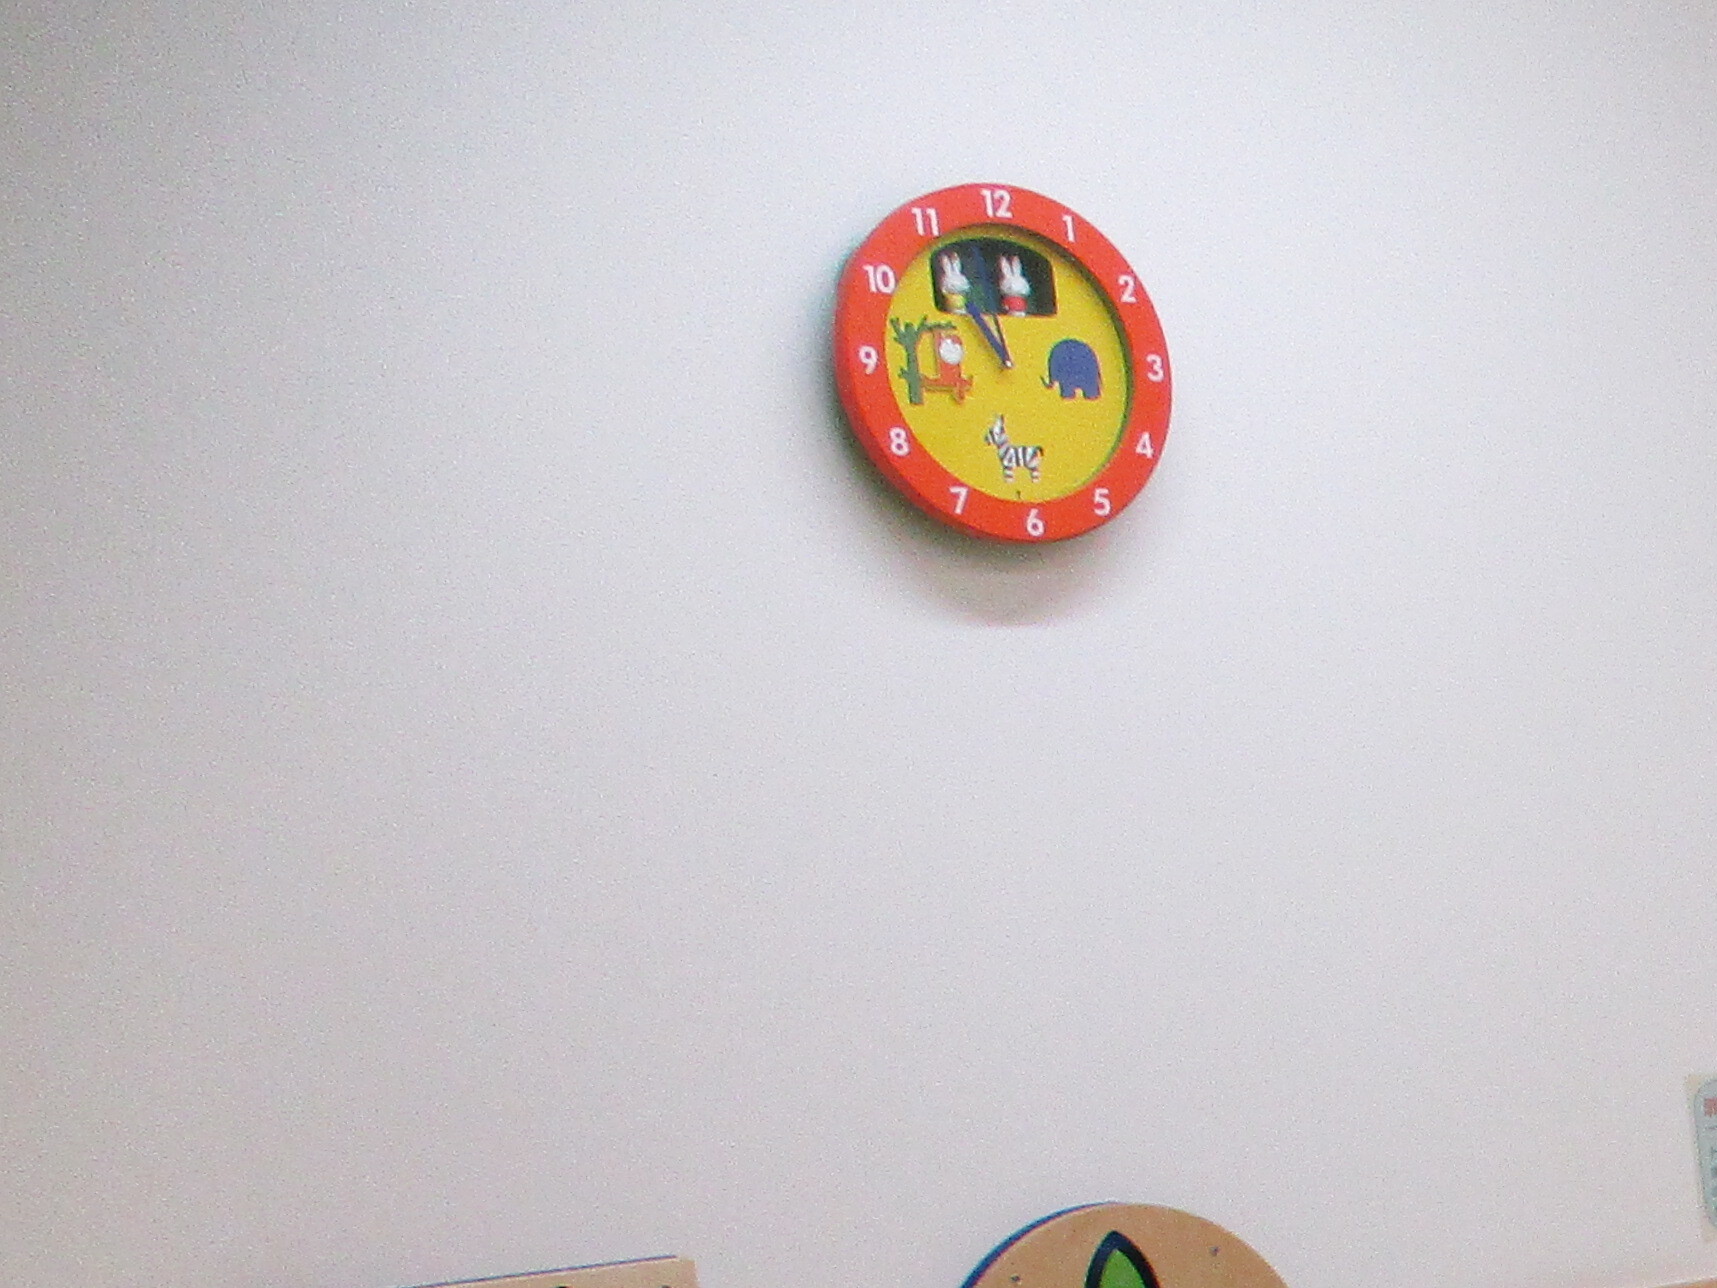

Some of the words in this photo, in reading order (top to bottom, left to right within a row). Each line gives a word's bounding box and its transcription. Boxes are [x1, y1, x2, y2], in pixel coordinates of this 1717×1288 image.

[981, 189, 1012, 218] 12
[912, 207, 938, 236] 11
[1063, 216, 1073, 241] 1
[864, 265, 896, 293] 10
[1119, 276, 1135, 303] 2
[860, 346, 876, 374] 9
[1147, 354, 1163, 381] 3
[890, 428, 909, 455] 8
[1137, 433, 1153, 458] 4
[950, 487, 967, 514] 7
[1095, 490, 1110, 515] 5
[1027, 509, 1044, 535] 6
